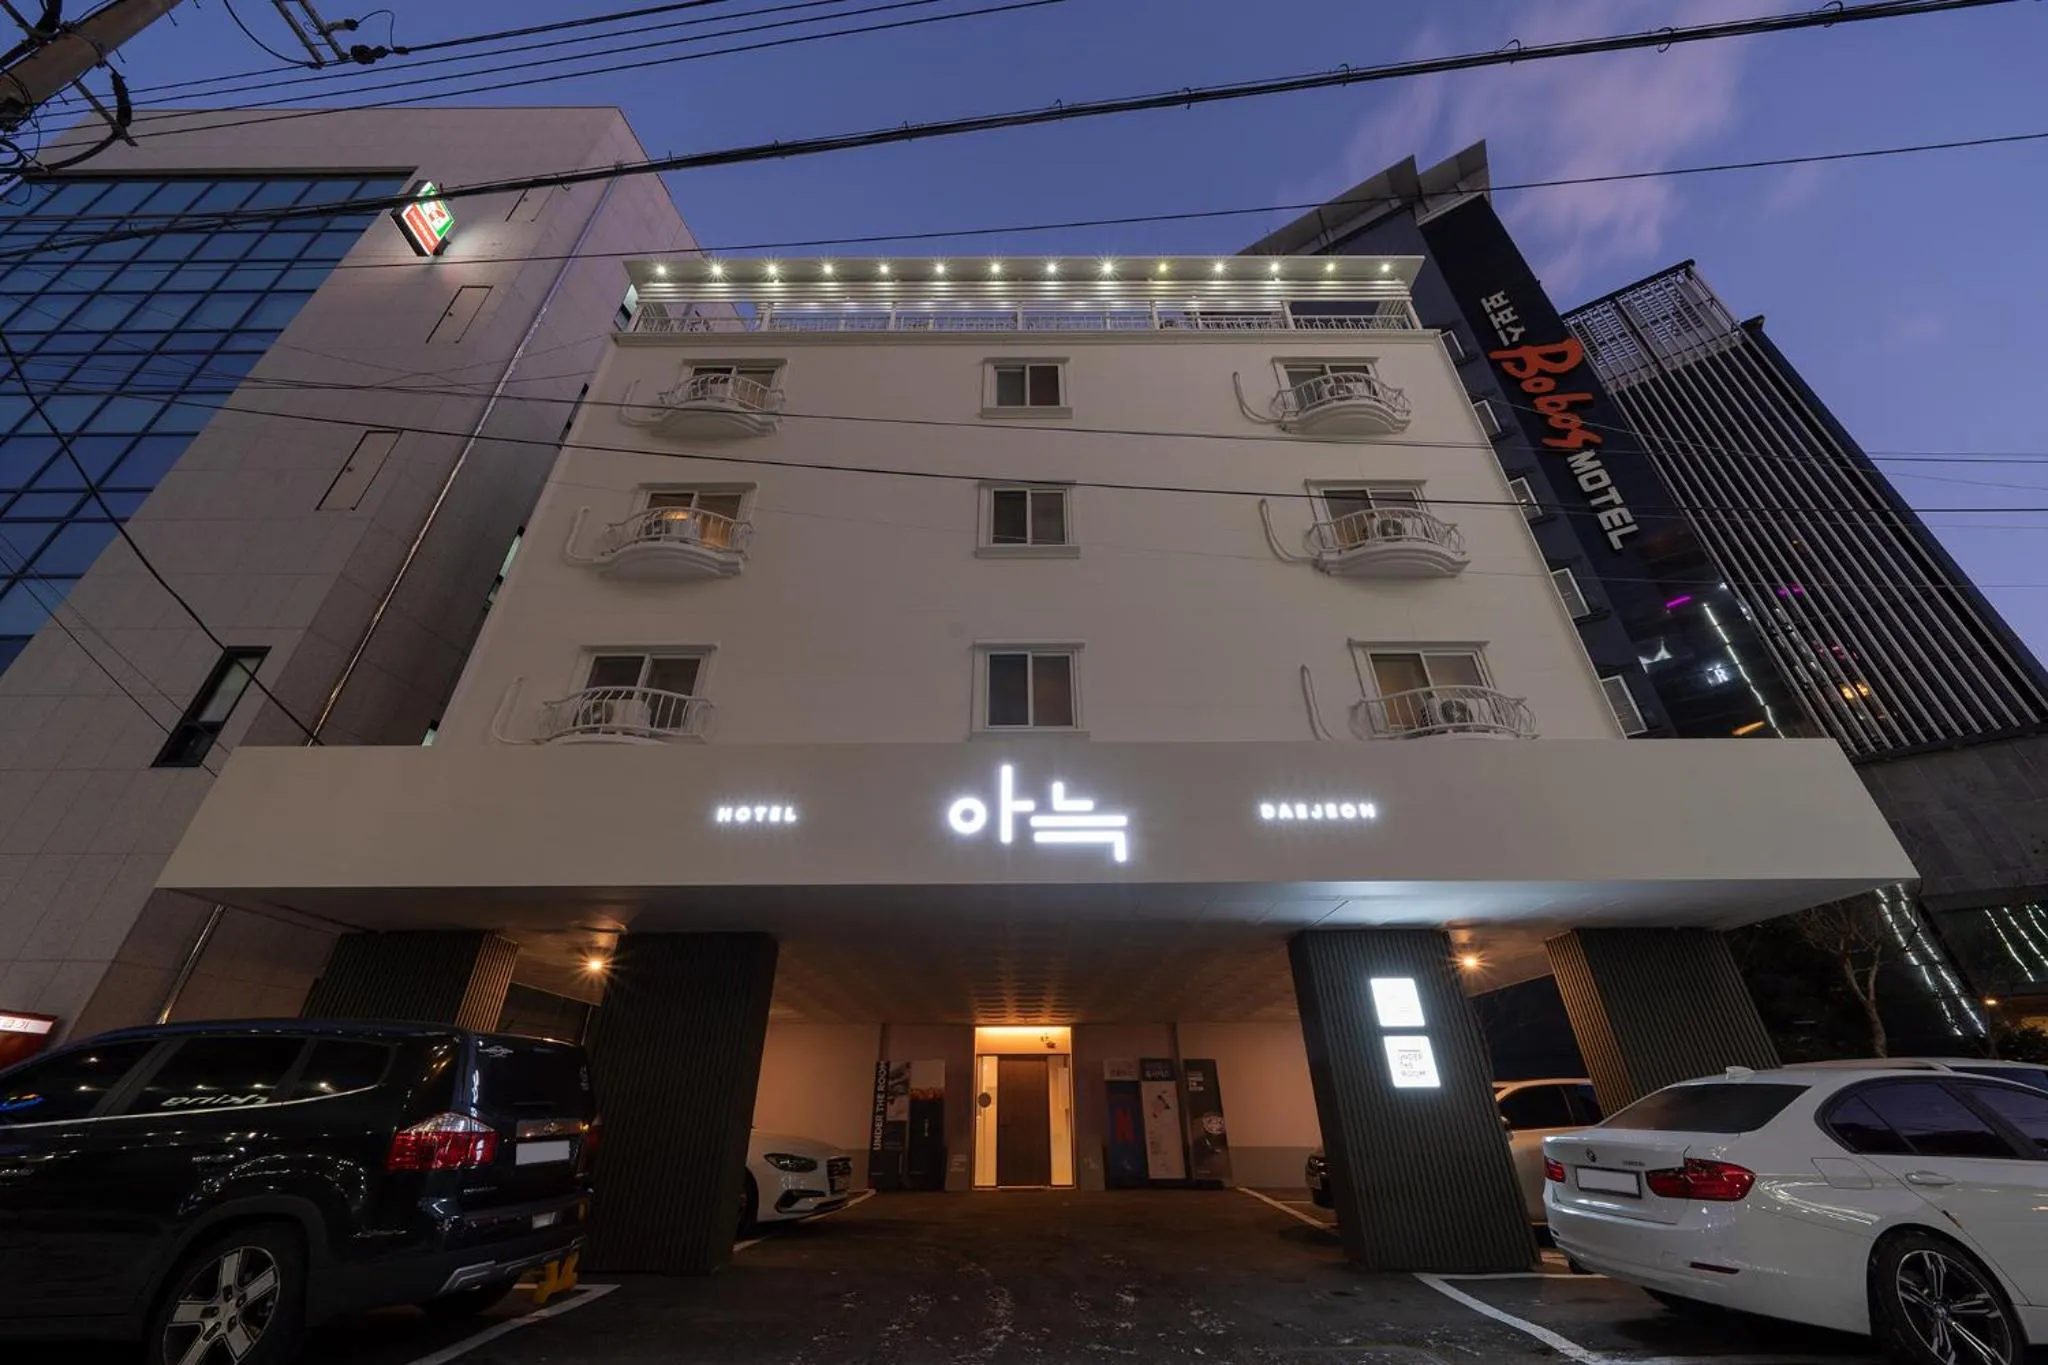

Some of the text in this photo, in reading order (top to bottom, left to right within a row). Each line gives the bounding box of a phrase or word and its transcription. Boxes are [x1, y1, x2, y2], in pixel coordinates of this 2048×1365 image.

[1481, 290, 1526, 346] 보보스
[1489, 339, 1640, 550] Bobos MOTEL
[717, 806, 797, 822] HOTEL
[947, 764, 1129, 863] 아늑
[1260, 803, 1376, 820] DAEJEON
[876, 1093, 886, 1113] THE
[873, 1115, 883, 1151] UNDER
